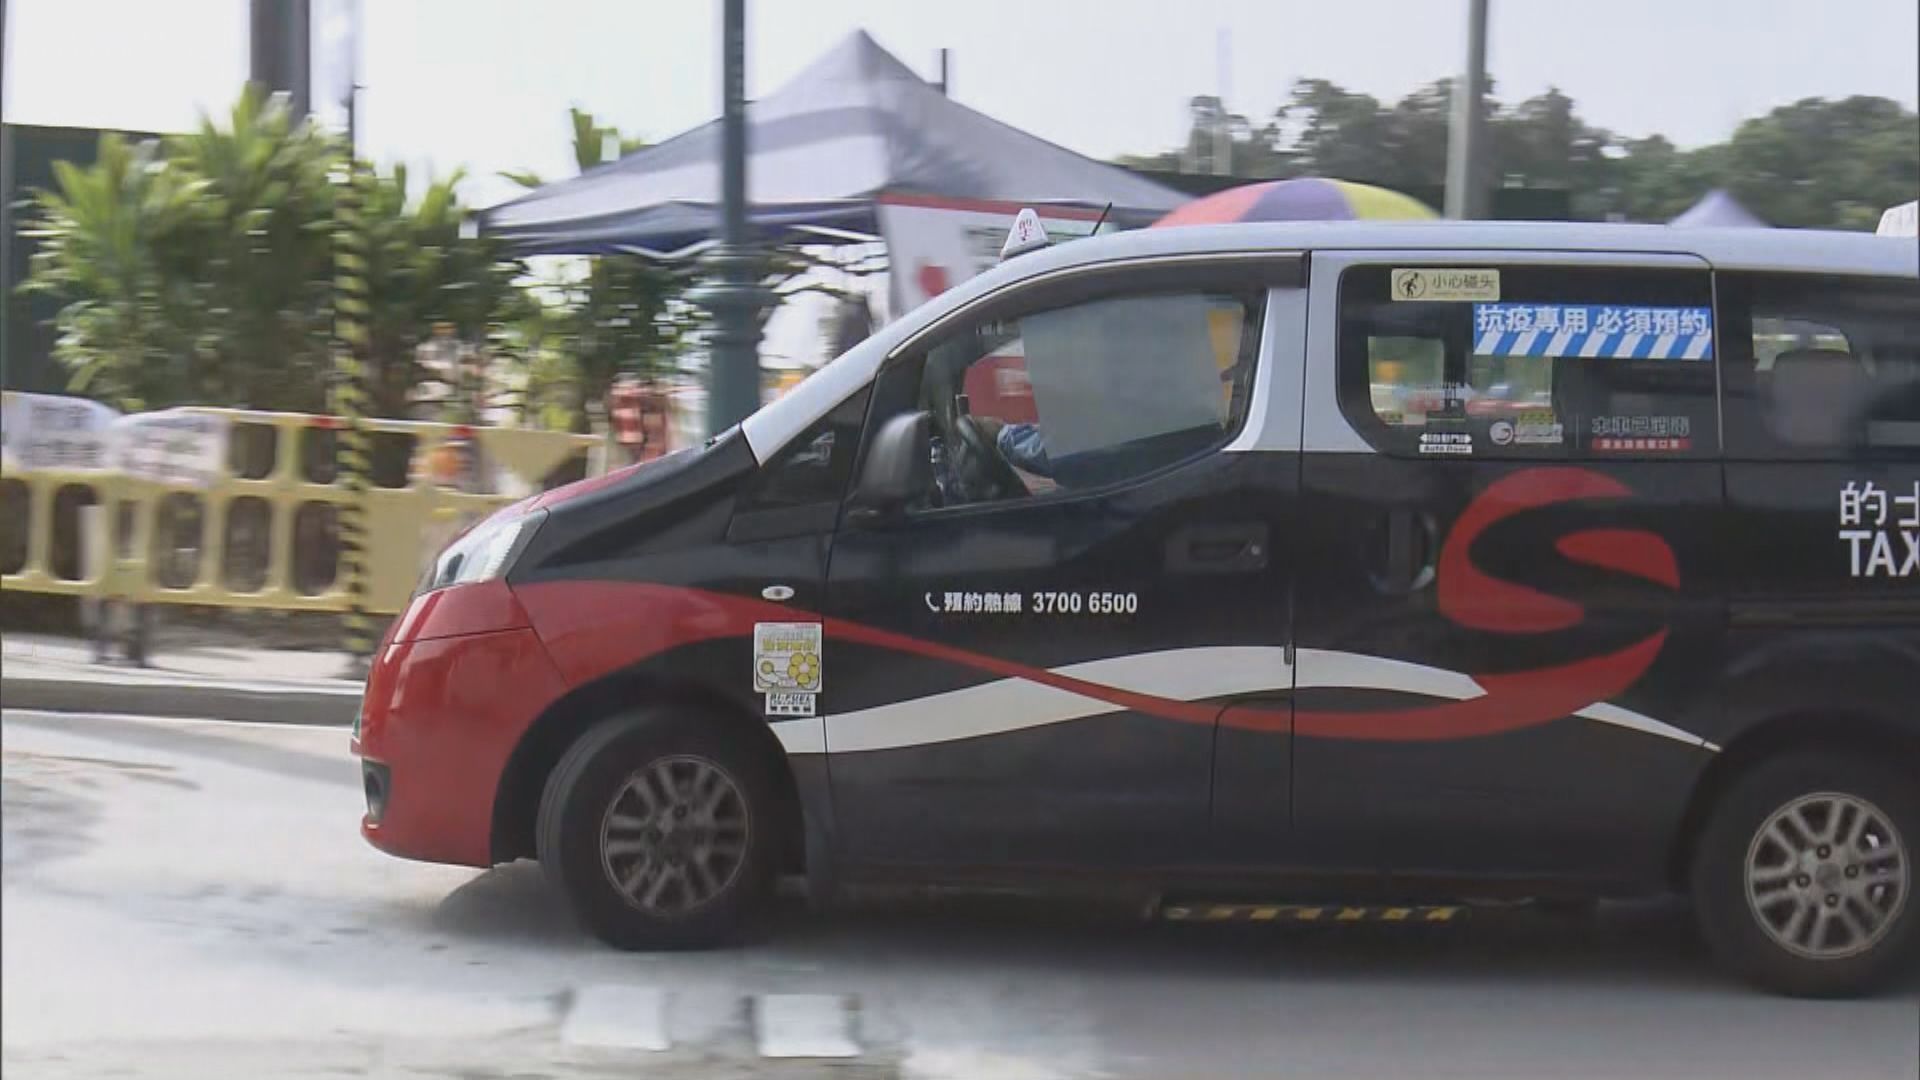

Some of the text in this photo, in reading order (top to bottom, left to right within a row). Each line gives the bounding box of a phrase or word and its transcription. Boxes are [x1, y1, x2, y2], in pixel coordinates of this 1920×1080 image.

[1477, 304, 1708, 335] 抗疫專用 必須預約
[1032, 592, 1081, 613] 3700
[1088, 592, 1138, 613] 6500
